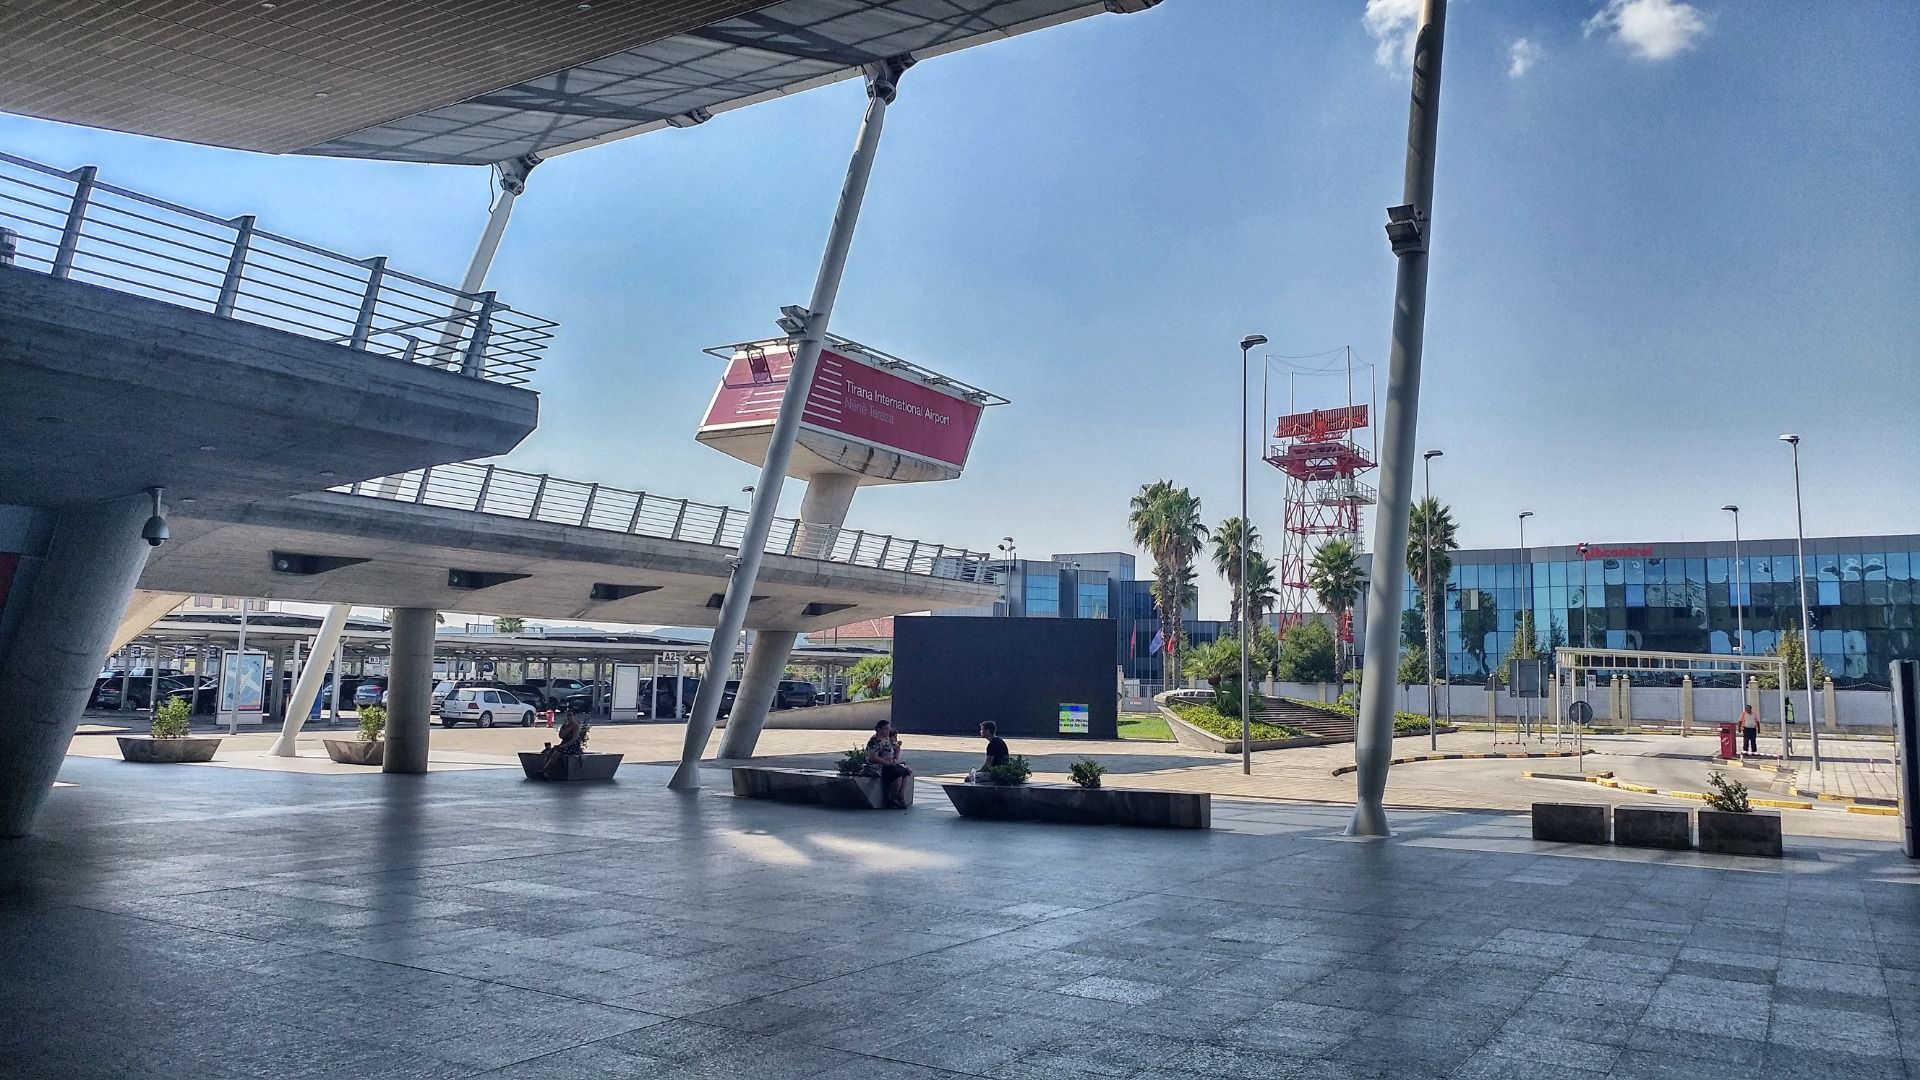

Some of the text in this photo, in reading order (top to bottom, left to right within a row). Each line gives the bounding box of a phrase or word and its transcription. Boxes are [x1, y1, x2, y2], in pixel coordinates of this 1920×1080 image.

[846, 380, 950, 425] Tirana International Airport
[869, 405, 894, 424] Tereza
[664, 652, 676, 661] A2
